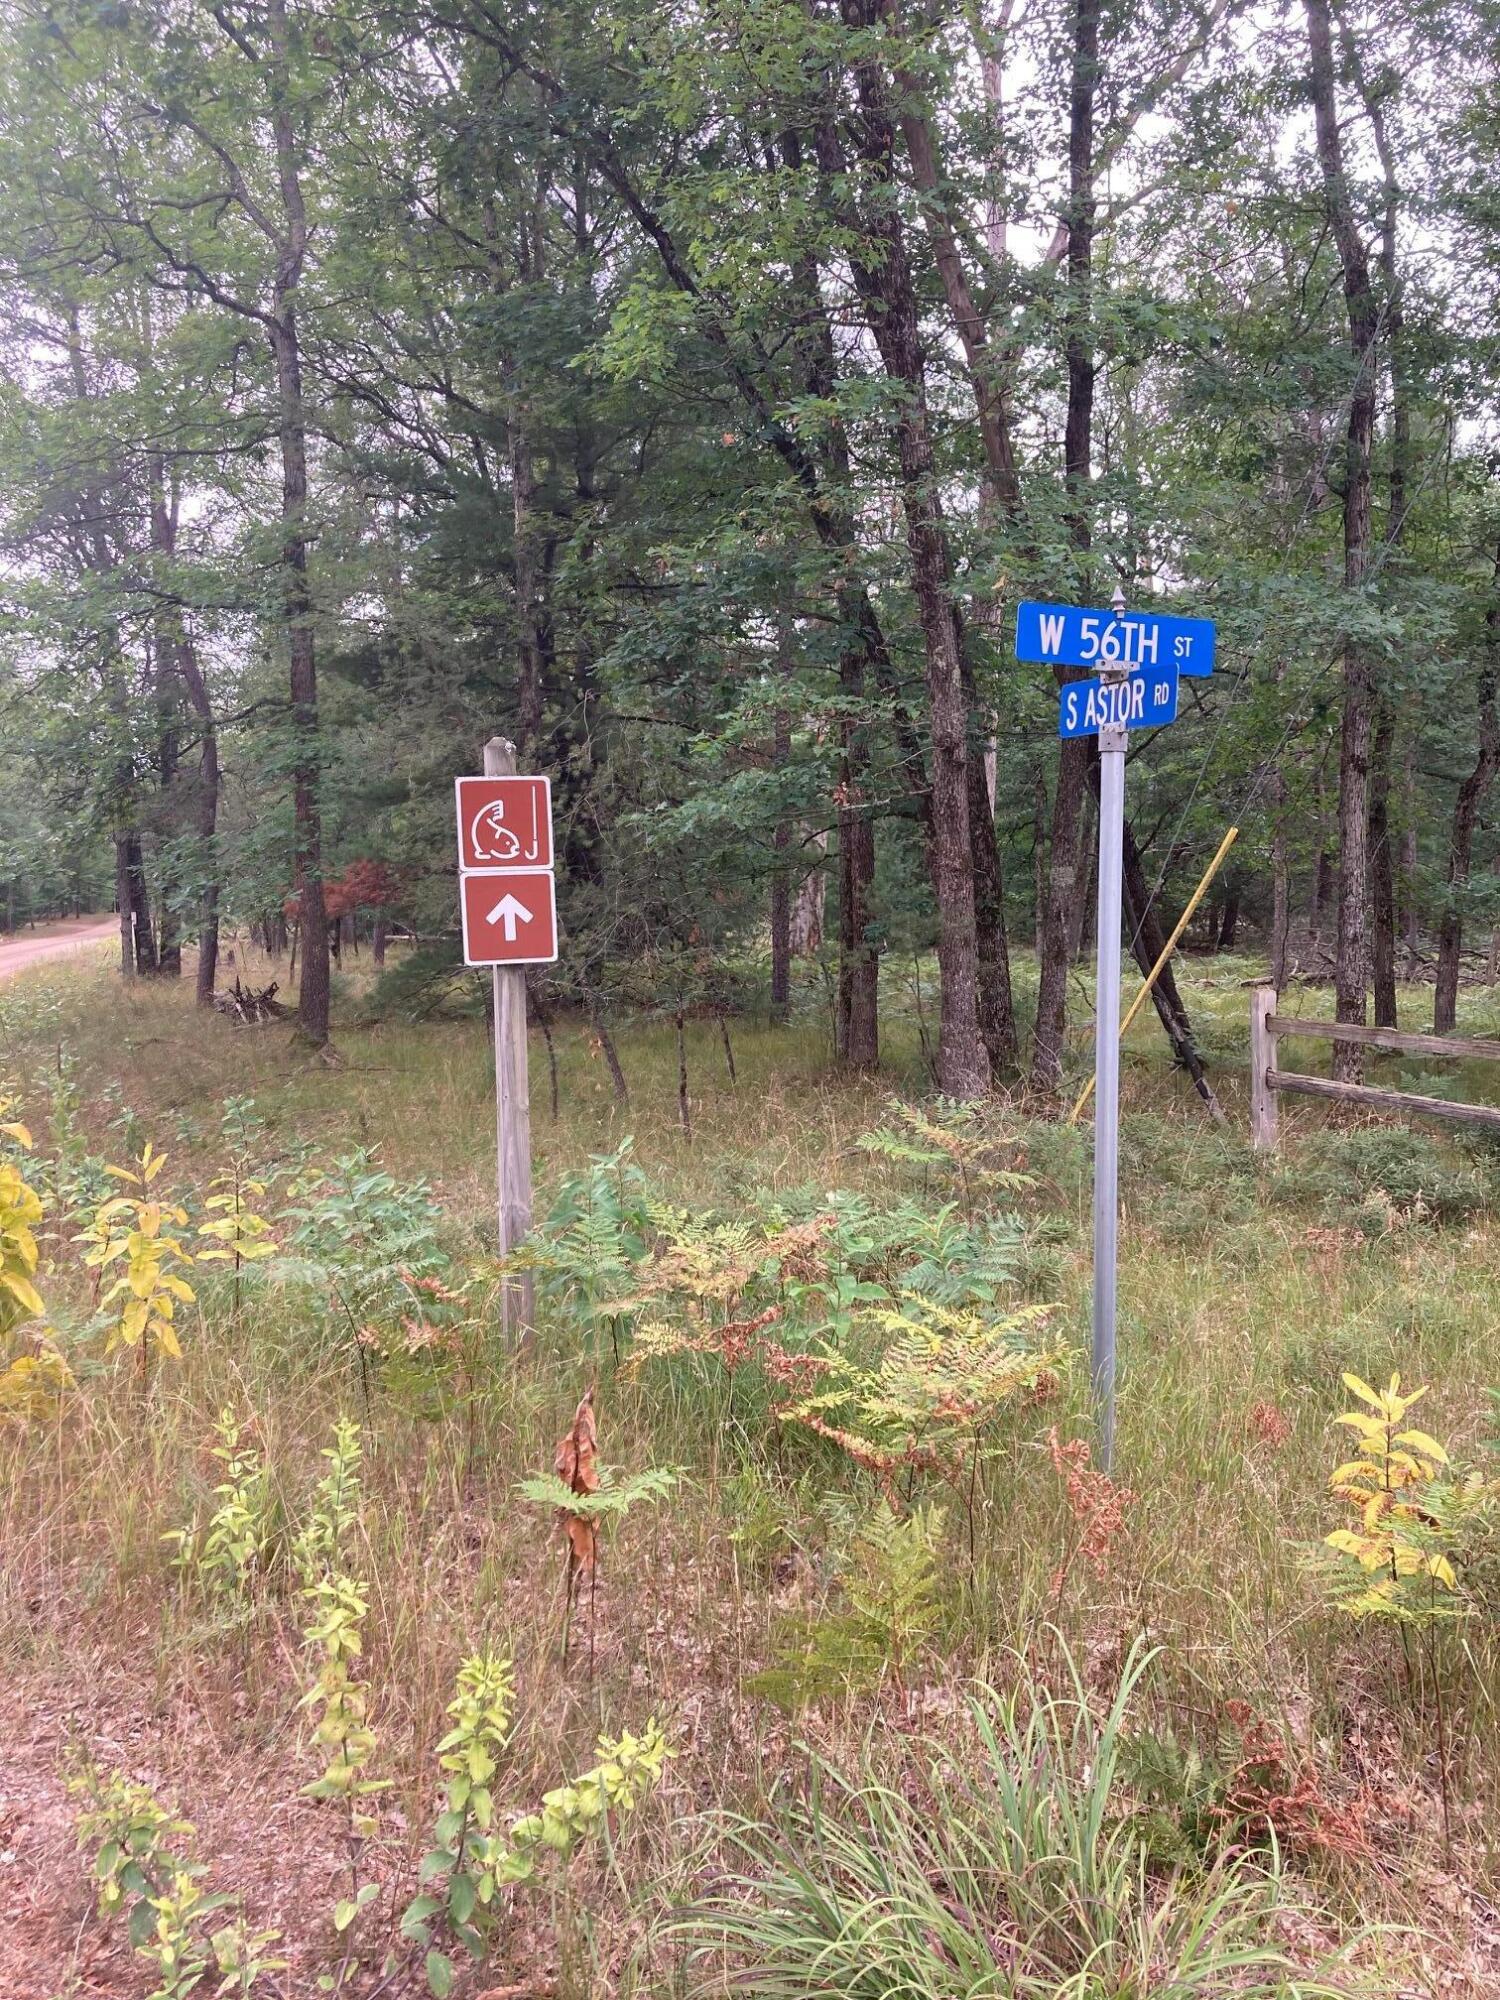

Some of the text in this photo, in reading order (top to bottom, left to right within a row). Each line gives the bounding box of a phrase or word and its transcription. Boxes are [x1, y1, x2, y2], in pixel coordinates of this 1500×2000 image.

[1039, 614, 1194, 664] W 56TH ST
[1066, 679, 1170, 730] S ASTOR RD
